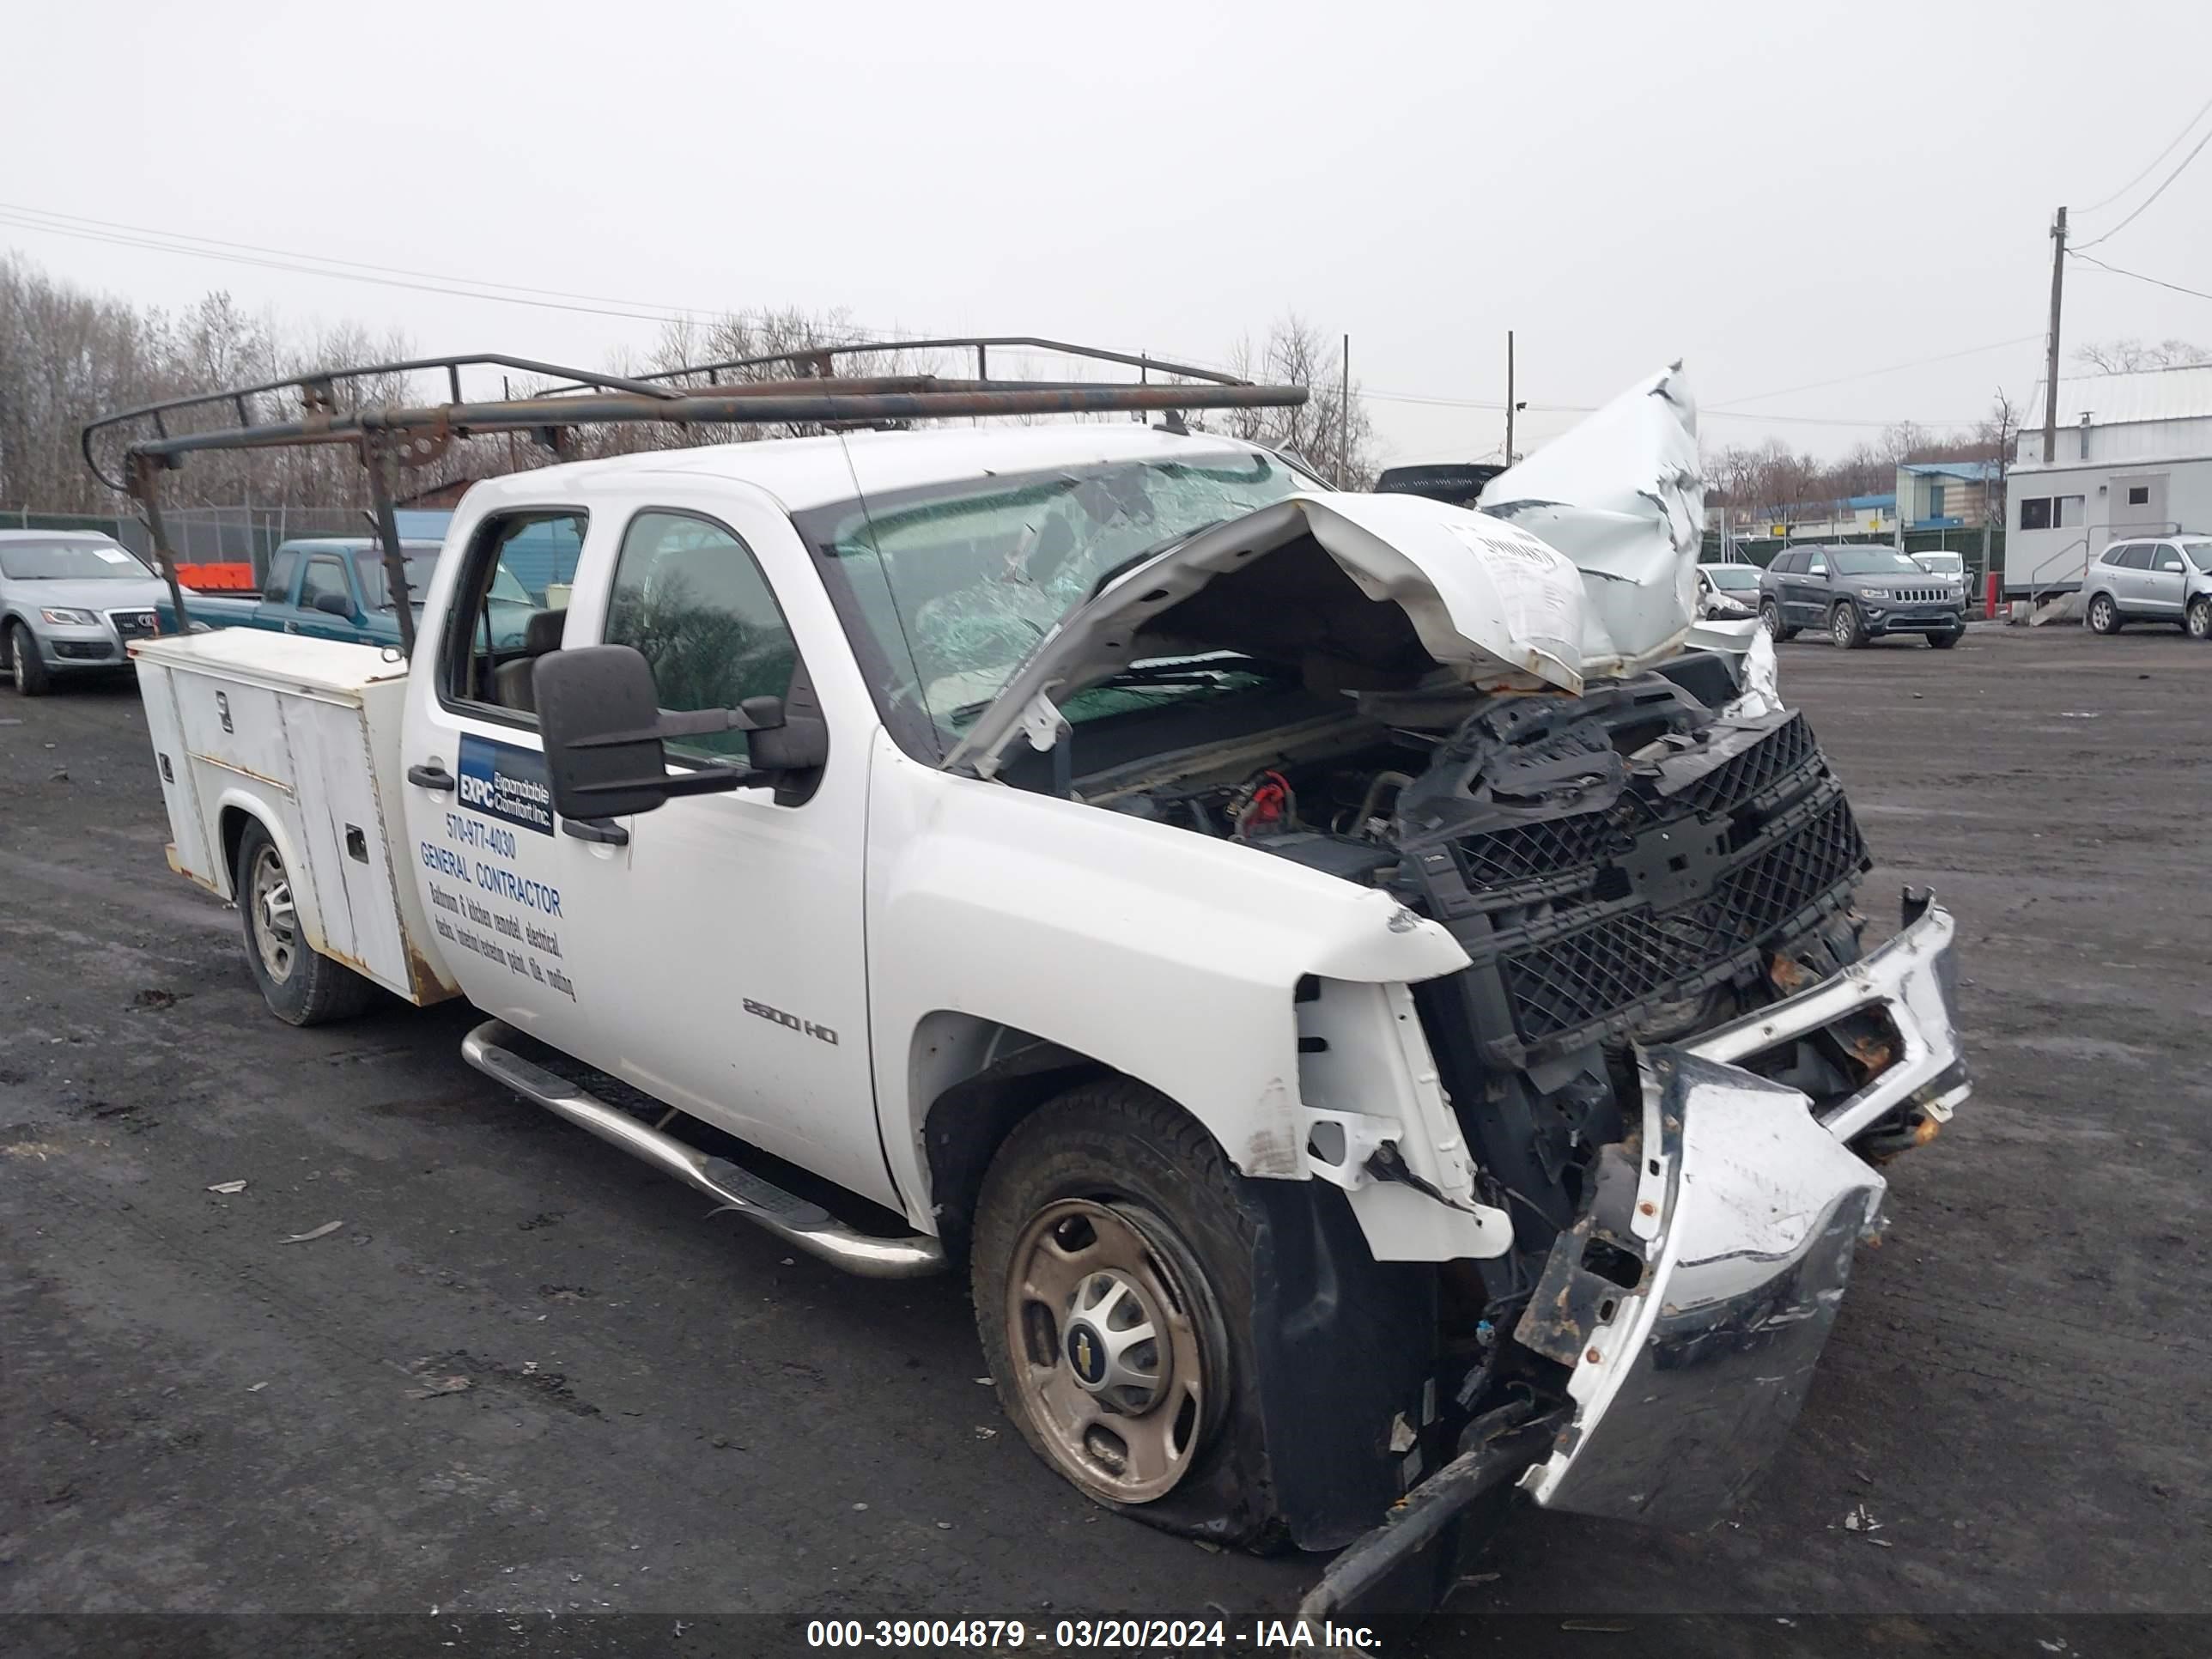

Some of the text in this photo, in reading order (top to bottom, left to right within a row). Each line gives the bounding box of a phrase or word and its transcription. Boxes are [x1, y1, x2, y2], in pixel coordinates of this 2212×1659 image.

[460, 774, 495, 807] EXPC
[495, 771, 550, 805] Expandable
[495, 793, 532, 821] Comfort
[446, 812, 516, 859] 570-977-4030
[420, 842, 563, 918] GENERAL CONTRACTOR
[429, 881, 459, 914] Bathroom
[466, 896, 493, 928] kitchen
[743, 998, 838, 1045] 2500 HD
